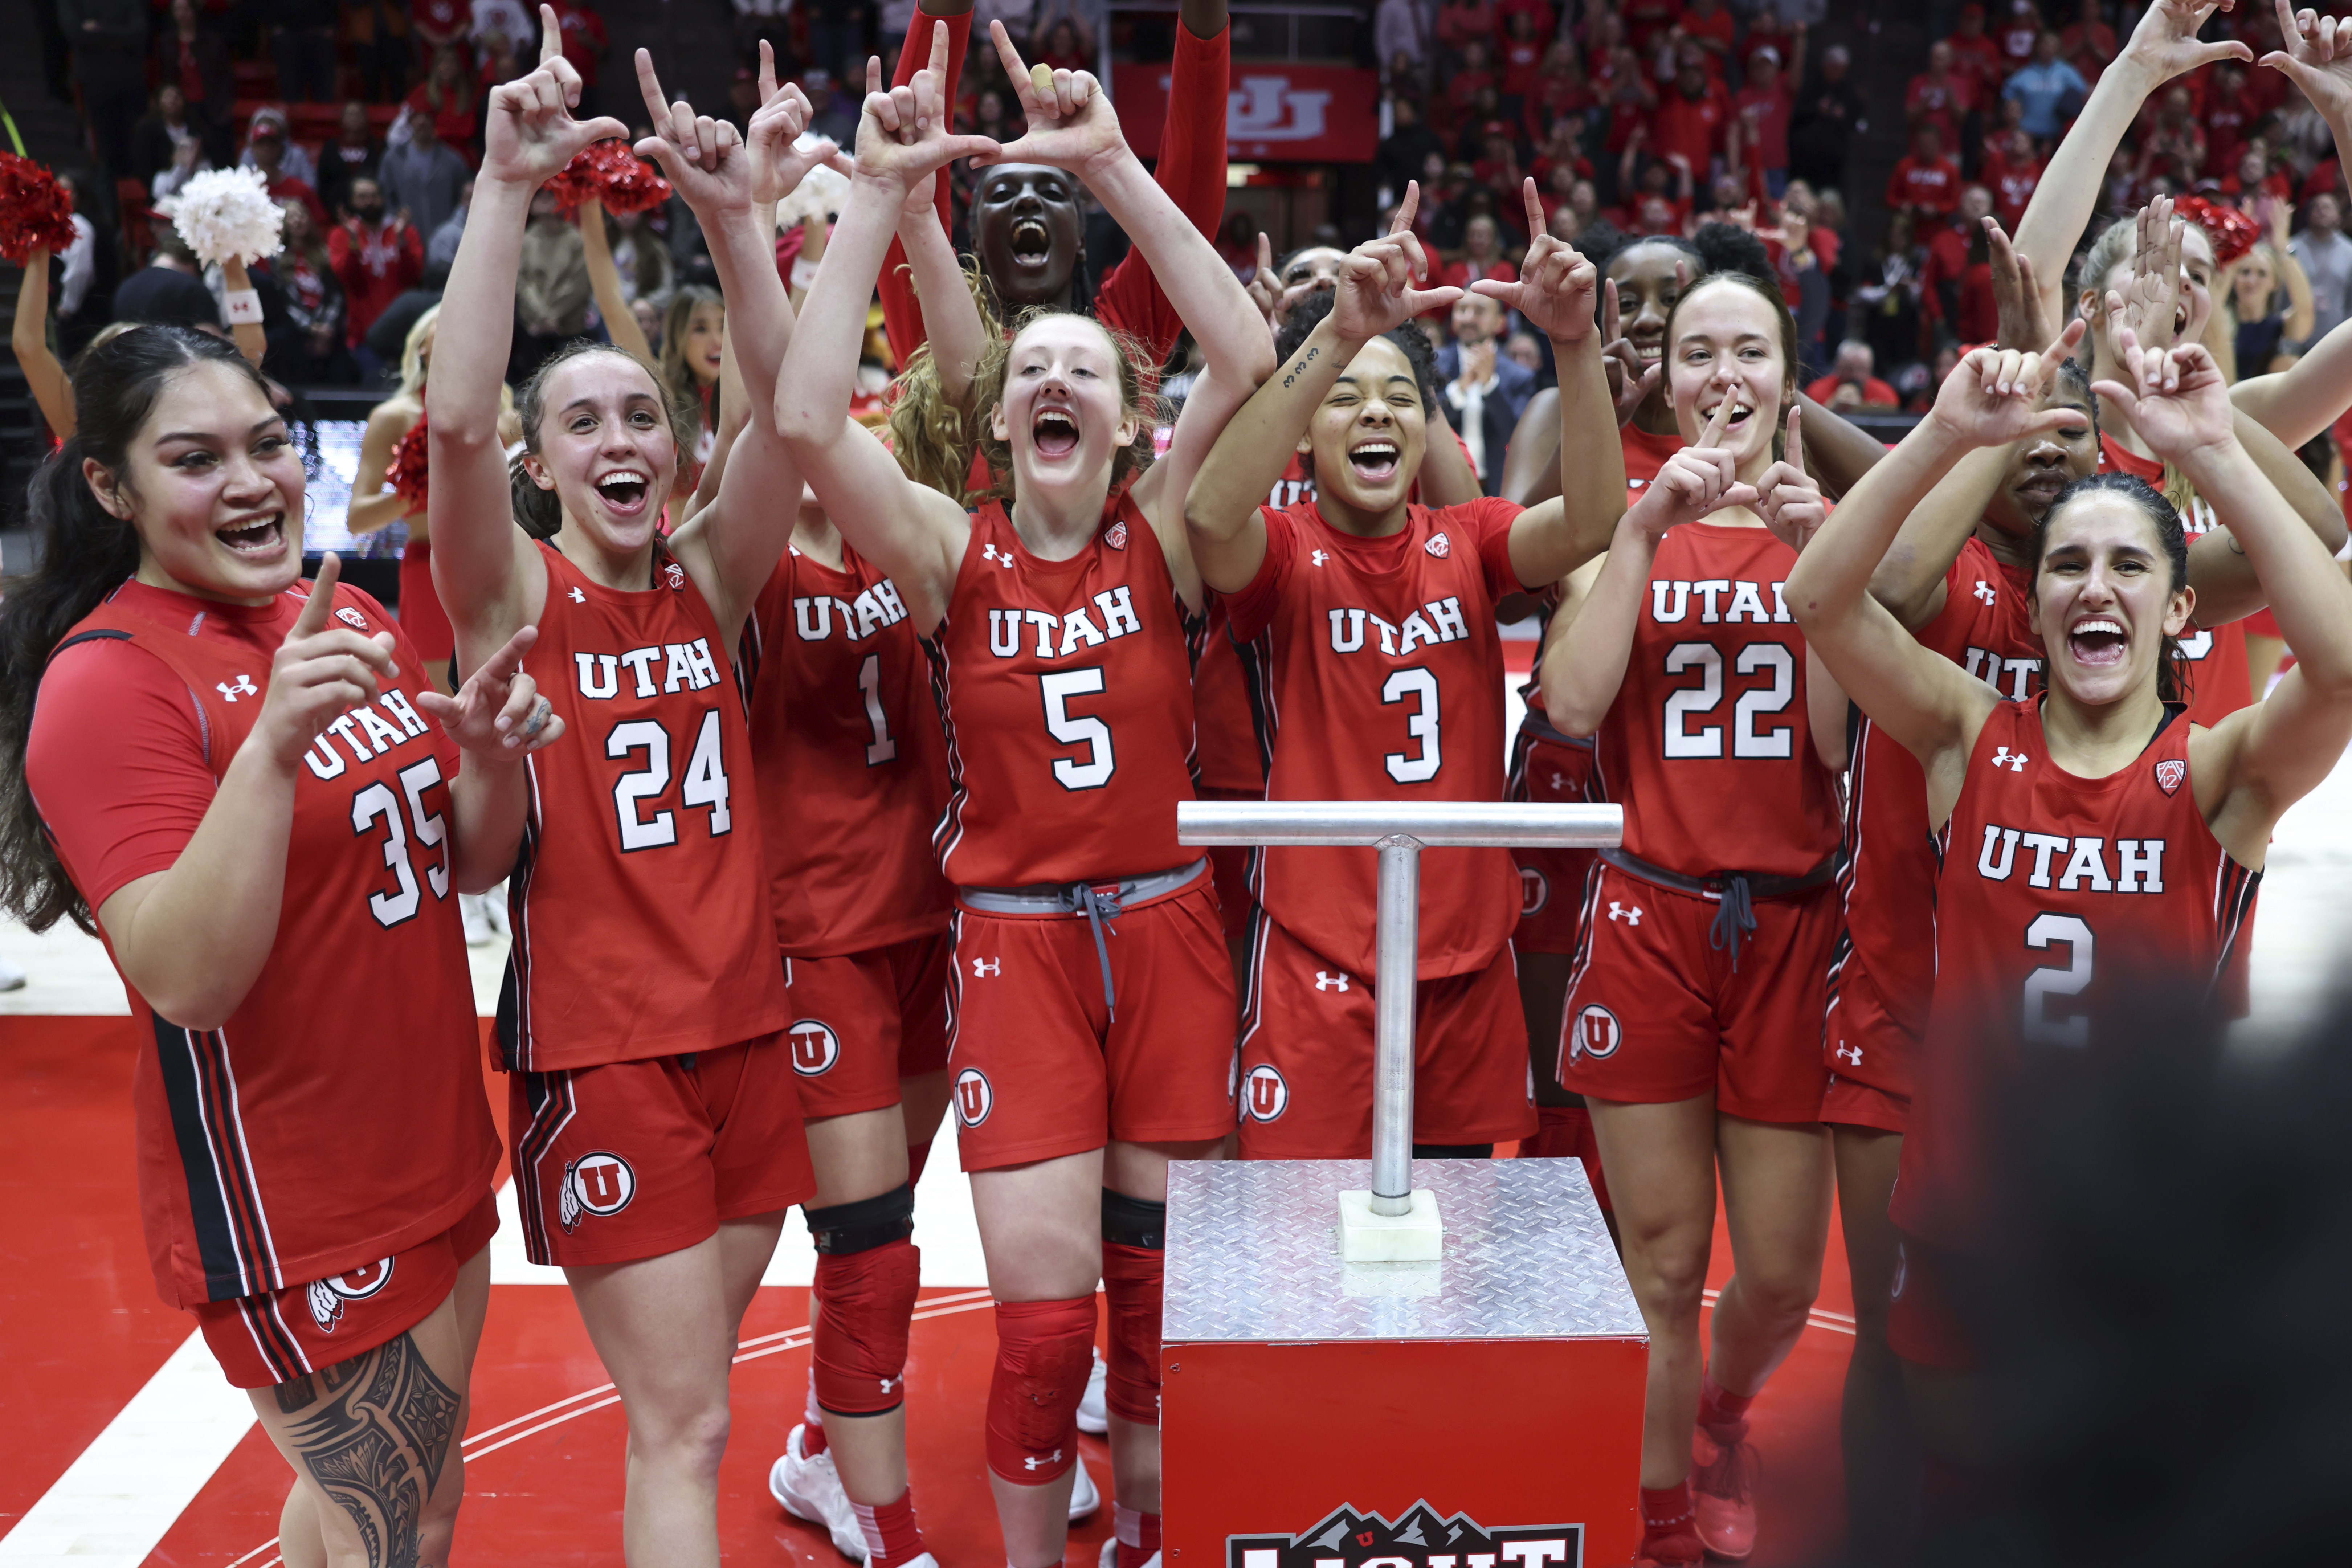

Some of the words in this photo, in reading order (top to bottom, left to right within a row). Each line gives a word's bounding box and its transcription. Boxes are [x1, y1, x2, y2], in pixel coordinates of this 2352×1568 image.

[1104, 521, 1127, 546] PAC
[1112, 533, 1126, 547] 12
[669, 575, 684, 588] 12
[793, 577, 910, 642] UTAH
[988, 584, 1143, 659] UTAH
[1328, 596, 1470, 657] UTAH
[573, 637, 722, 700] UTAH
[857, 651, 898, 768] 1
[1038, 665, 1117, 792] 5
[1380, 665, 1443, 785] 3
[1662, 641, 1796, 760] 22
[302, 687, 431, 781] UTAH
[604, 707, 732, 854] 24
[2156, 760, 2185, 783] PAC
[2163, 775, 2178, 788] 12
[350, 753, 450, 931] 35
[1976, 822, 2166, 894] UTAH
[2022, 910, 2097, 1048] 2
[790, 1030, 827, 1069] U
[1584, 1014, 1611, 1052] U
[959, 1079, 983, 1119] U
[1252, 1076, 1279, 1115] U
[579, 1163, 622, 1208] U
[1356, 1531, 1374, 1547] U
